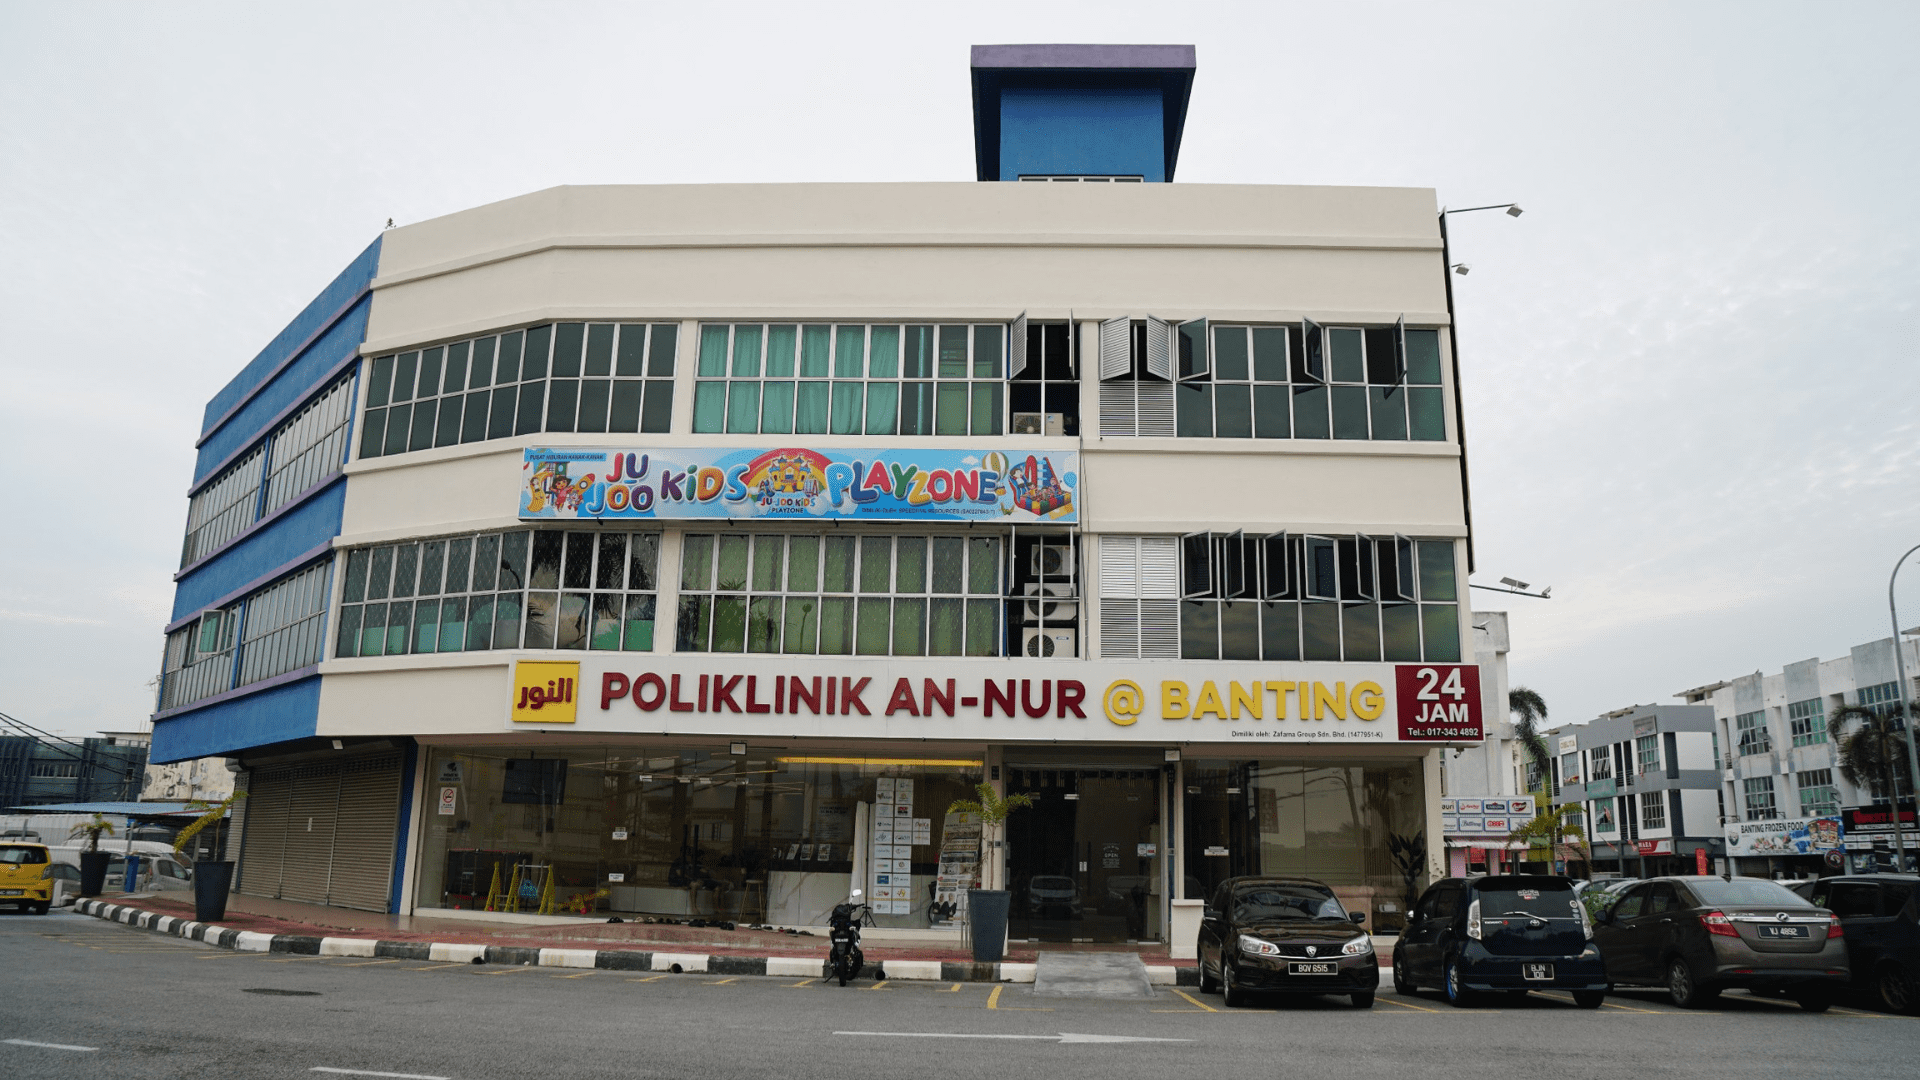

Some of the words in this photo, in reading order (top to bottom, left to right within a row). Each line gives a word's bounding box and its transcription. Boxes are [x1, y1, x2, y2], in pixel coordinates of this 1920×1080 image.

[825, 459, 999, 507] PLAYZONE
[586, 482, 654, 514] JOO
[517, 677, 573, 711] النور
[1416, 667, 1466, 701] 24
[601, 672, 871, 716] POLIKLINIK
[885, 677, 1087, 719] AN-NUR
[1103, 678, 1145, 727] @
[1160, 680, 1386, 722] BANTING
[1415, 703, 1469, 723] JAM
[1231, 730, 1255, 738] Dimiliki
[1255, 730, 1271, 738] oleh:
[1297, 731, 1316, 739] Group
[1347, 730, 1383, 739] (1477951-K)
[1407, 727, 1425, 736] Tel.:
[1426, 727, 1458, 736] 017-343
[1459, 727, 1479, 736] 4892
[1740, 823, 1765, 834] BANTING
[1765, 822, 1787, 832] FROZEN
[1787, 821, 1804, 831] FOOD
[1298, 964, 1312, 973] BQV
[1312, 964, 1329, 973] 6515
